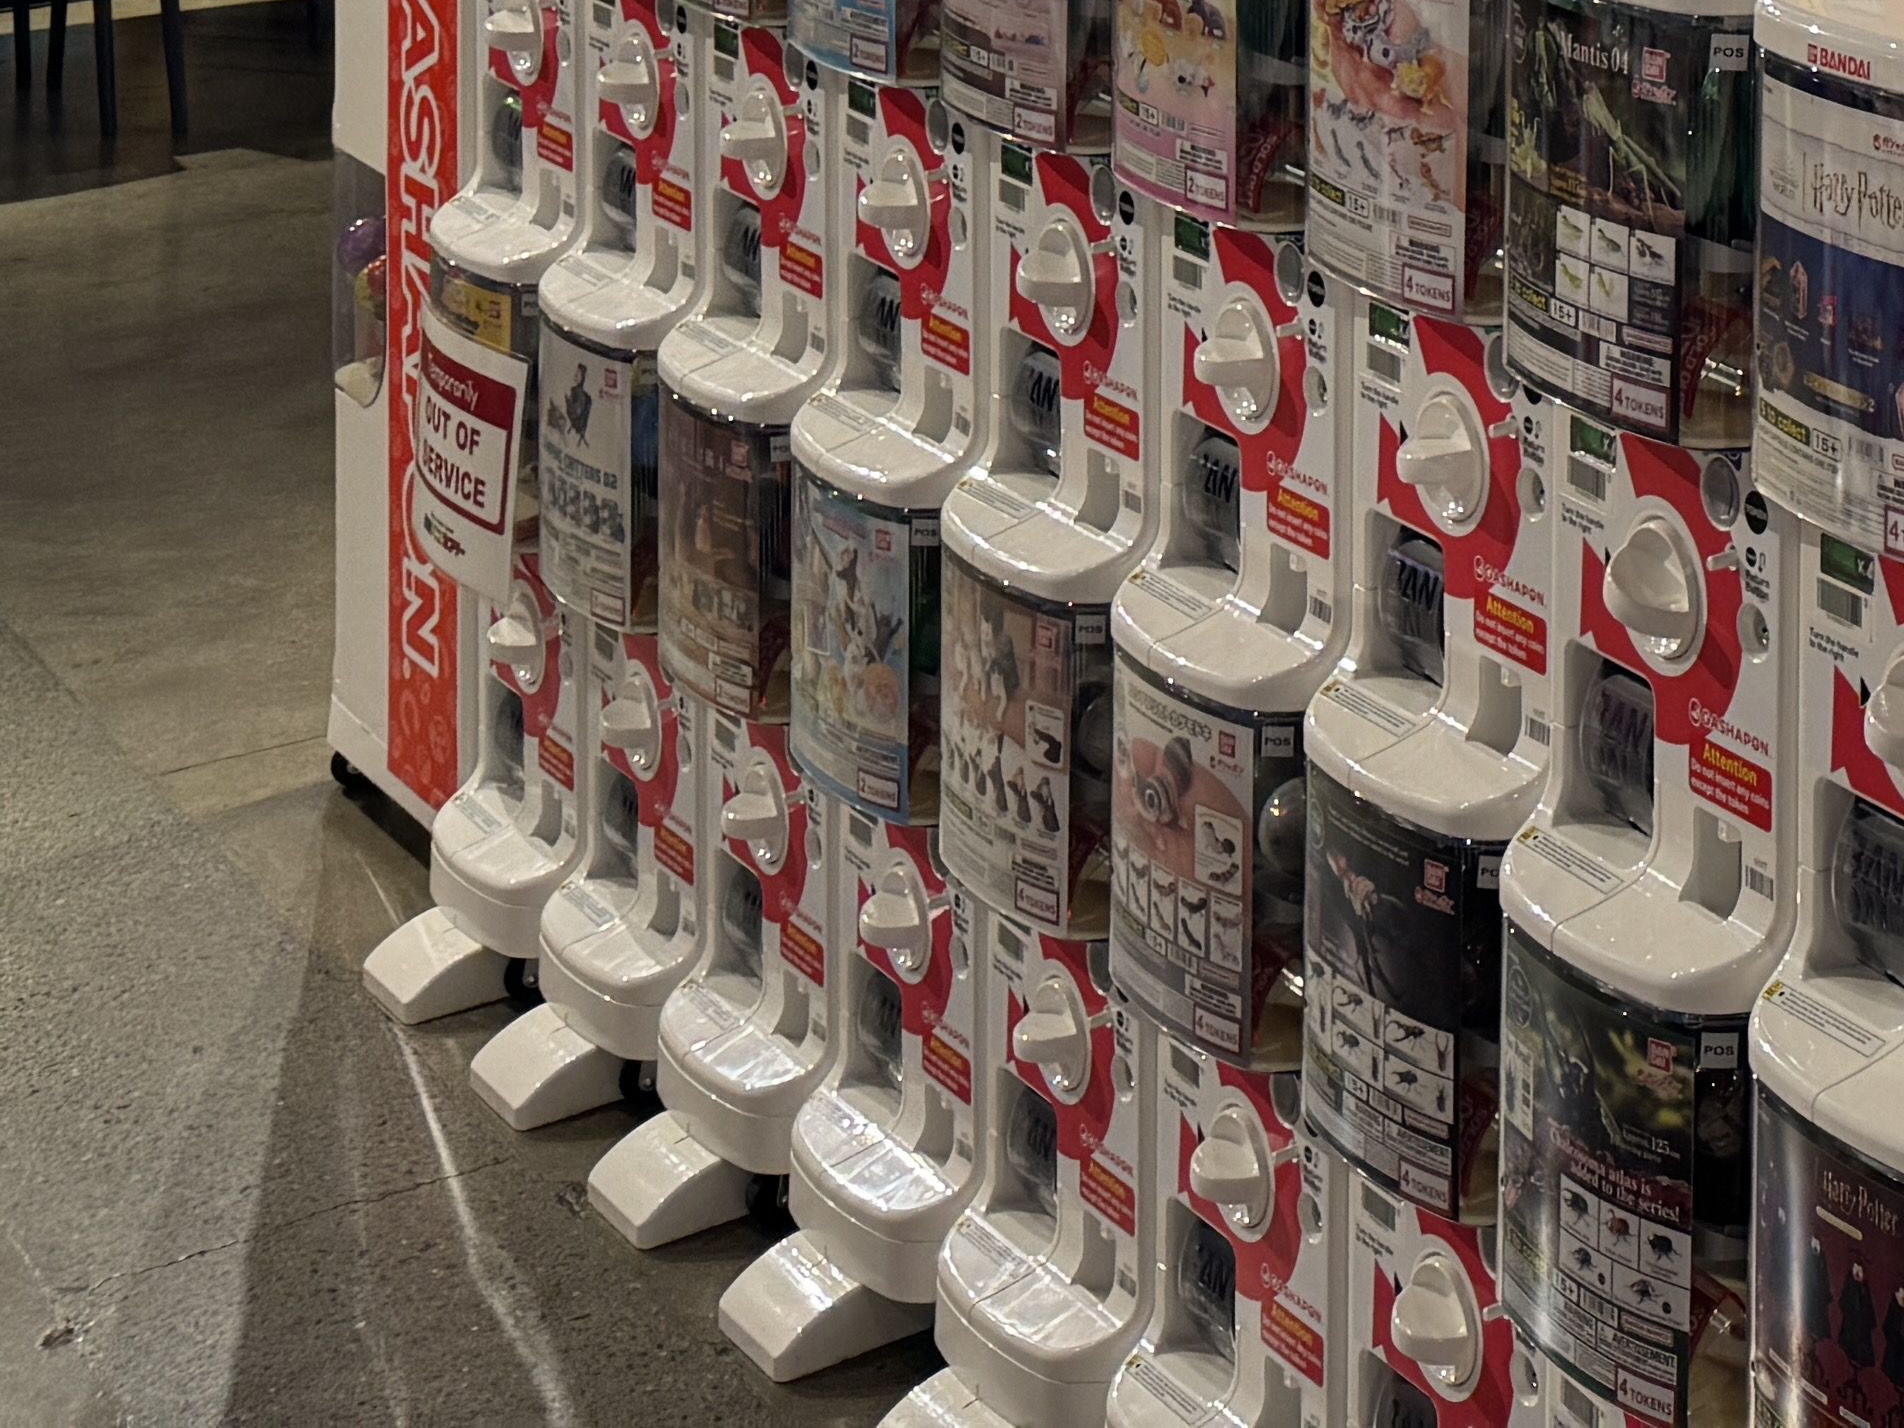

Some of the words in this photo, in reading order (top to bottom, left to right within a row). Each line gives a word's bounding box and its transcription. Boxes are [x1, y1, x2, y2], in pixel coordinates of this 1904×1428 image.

[1821, 48, 1871, 81] BANDAI
[1812, 164, 1857, 219] Harry
[425, 396, 450, 441] OUT
[456, 420, 481, 456] OF
[422, 439, 486, 509] SERVICE
[1888, 520, 1899, 541] 4
